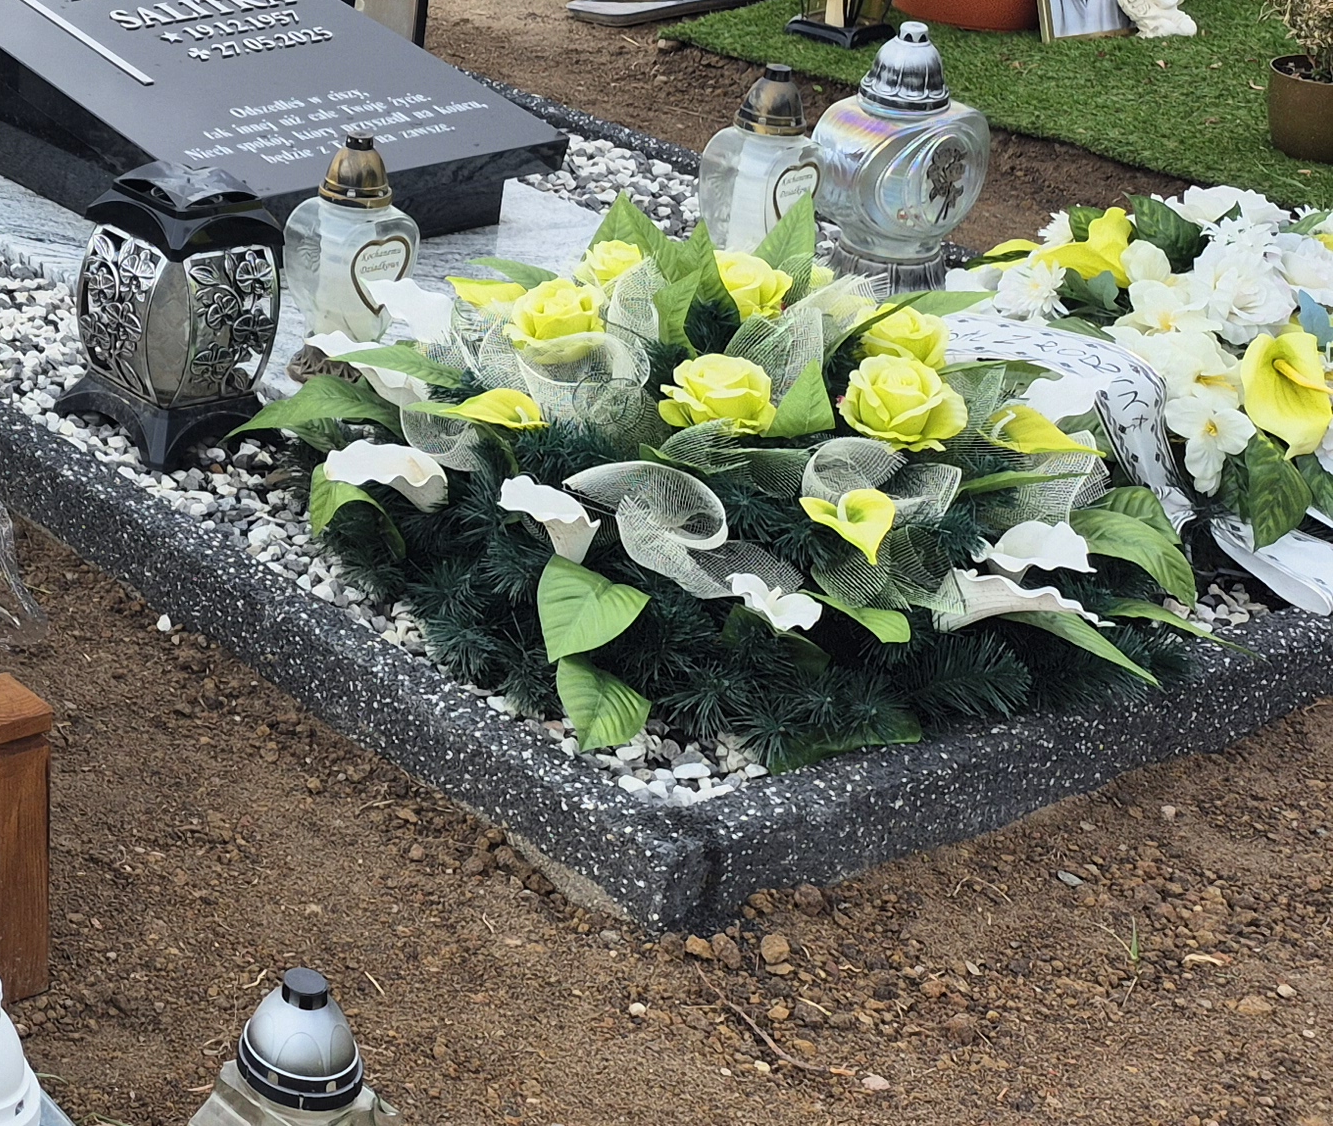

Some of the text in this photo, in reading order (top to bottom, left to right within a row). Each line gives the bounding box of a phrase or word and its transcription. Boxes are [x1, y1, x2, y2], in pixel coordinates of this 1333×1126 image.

[181, 9, 300, 42] 19.12.1957
[211, 26, 333, 59] 27.05.2025
[307, 95, 322, 105] w
[327, 88, 370, 102] ciszy,
[184, 144, 234, 161] Niech
[236, 133, 295, 154] spokój,
[291, 125, 339, 142] który
[412, 109, 435, 120] na
[203, 127, 234, 141] tak
[232, 118, 278, 135] innej
[337, 99, 388, 116] Twoje
[260, 123, 456, 165] będzie z na zawsze.
